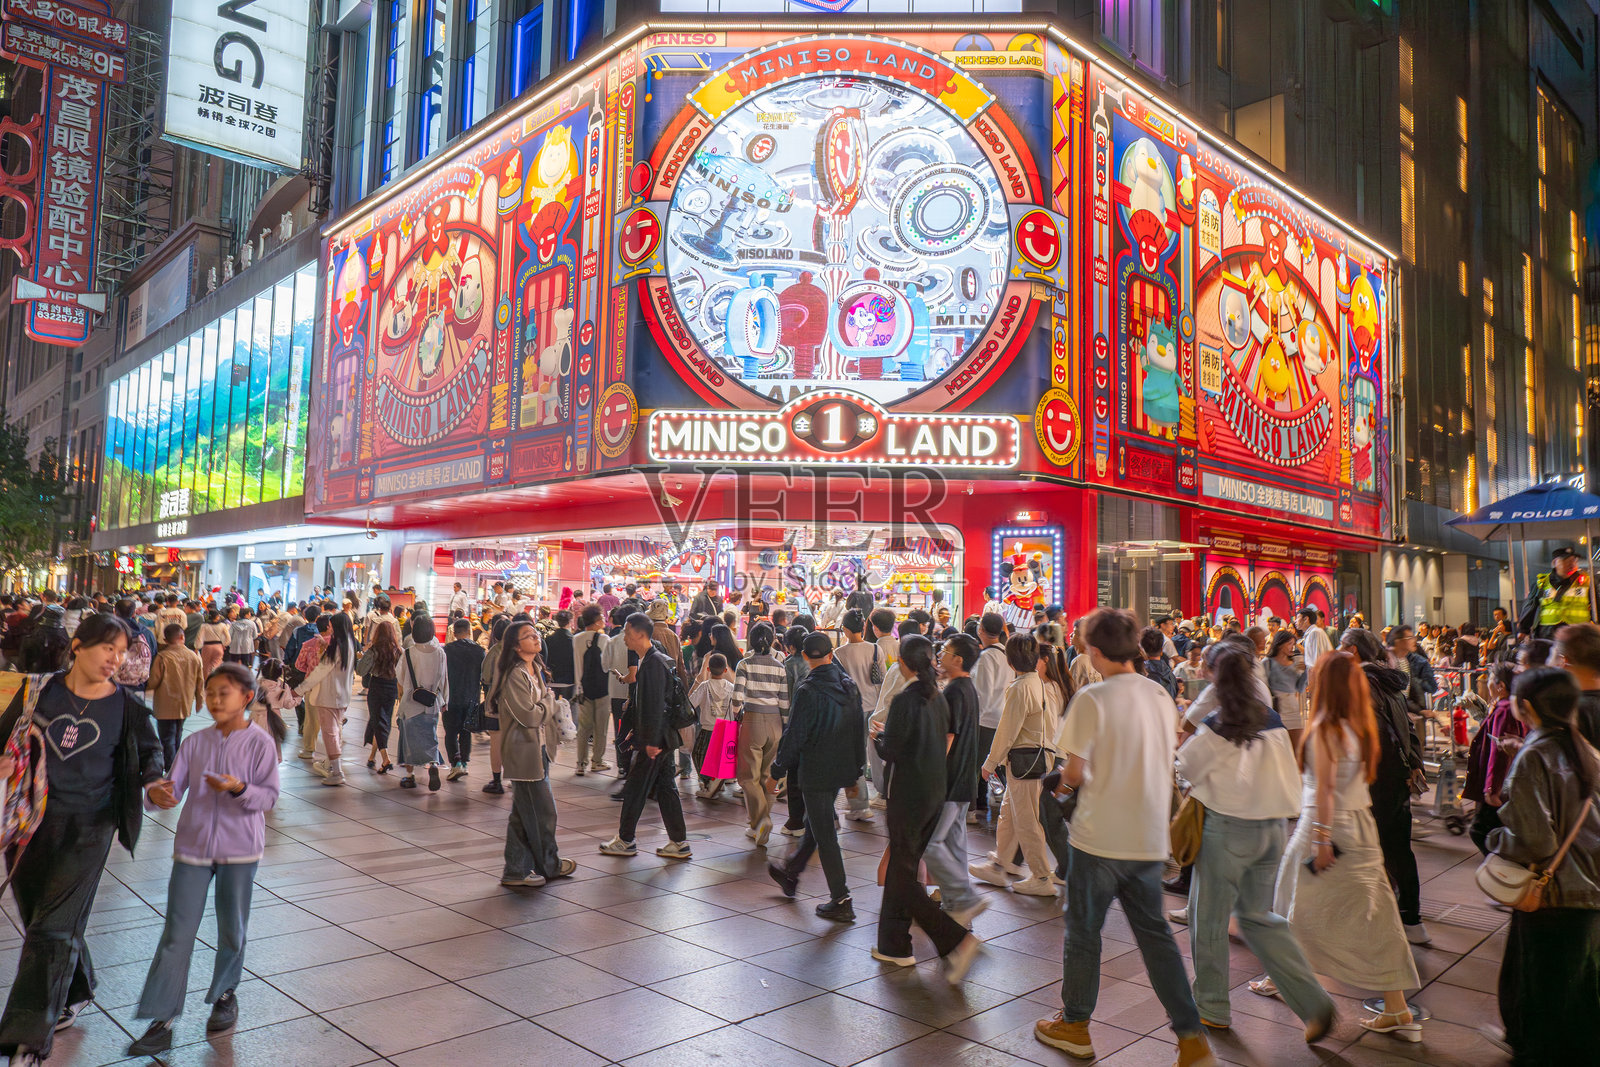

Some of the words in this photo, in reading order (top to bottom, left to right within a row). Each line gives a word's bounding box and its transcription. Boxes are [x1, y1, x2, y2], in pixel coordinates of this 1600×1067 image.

[78, 17, 126, 44] 眼镜
[647, 33, 717, 47] MINISO
[7, 38, 92, 71] 九江路458号
[93, 52, 123, 77] 9F
[740, 48, 850, 83] MINISO
[866, 50, 936, 80] LAND
[955, 55, 1006, 65] MINISO
[1009, 56, 1043, 66] LAND
[199, 84, 278, 124] 波司登
[197, 107, 276, 138] 畅销全球72国
[660, 127, 702, 188] MINISO
[43, 74, 97, 287] 茂昌眼镜验配中心
[447, 172, 470, 184] LAND
[999, 155, 1026, 199] LAND
[587, 193, 599, 206] MINI
[1094, 199, 1107, 211] MINI
[1201, 209, 1219, 231] 消防
[1242, 192, 1278, 209] MINISO
[1282, 206, 1303, 238] LAND
[520, 265, 537, 288] MINISO
[584, 255, 597, 268] MINI
[1094, 260, 1107, 273] MINI
[1121, 262, 1135, 286] LAND
[49, 288, 77, 302] VIP
[1163, 276, 1177, 306] LAND
[37, 302, 85, 317] 预约电话
[37, 311, 84, 325] 63225722
[617, 286, 626, 336] MINISO
[655, 286, 691, 350] MINISO
[687, 349, 725, 387] LAND
[944, 339, 999, 396] MINISO
[994, 295, 1022, 340] LAND
[616, 340, 624, 375] LAND
[1202, 350, 1220, 371] 消防
[381, 389, 431, 438] MINISO
[437, 363, 481, 429] LAND
[660, 420, 786, 453] MINISO
[795, 419, 811, 433] 全
[822, 406, 846, 444] 1
[859, 418, 875, 433] 球
[887, 424, 998, 457] LAND
[1221, 376, 1282, 457] MINISO
[1288, 412, 1325, 458] LAND
[377, 472, 407, 494] MINISO
[409, 466, 451, 489] 全球壹号店
[451, 460, 481, 482] LAND
[1218, 476, 1256, 503] MINISO
[1257, 485, 1298, 510] 全球壹号店
[1300, 496, 1324, 517] LAND
[1511, 508, 1574, 519] POLICE
